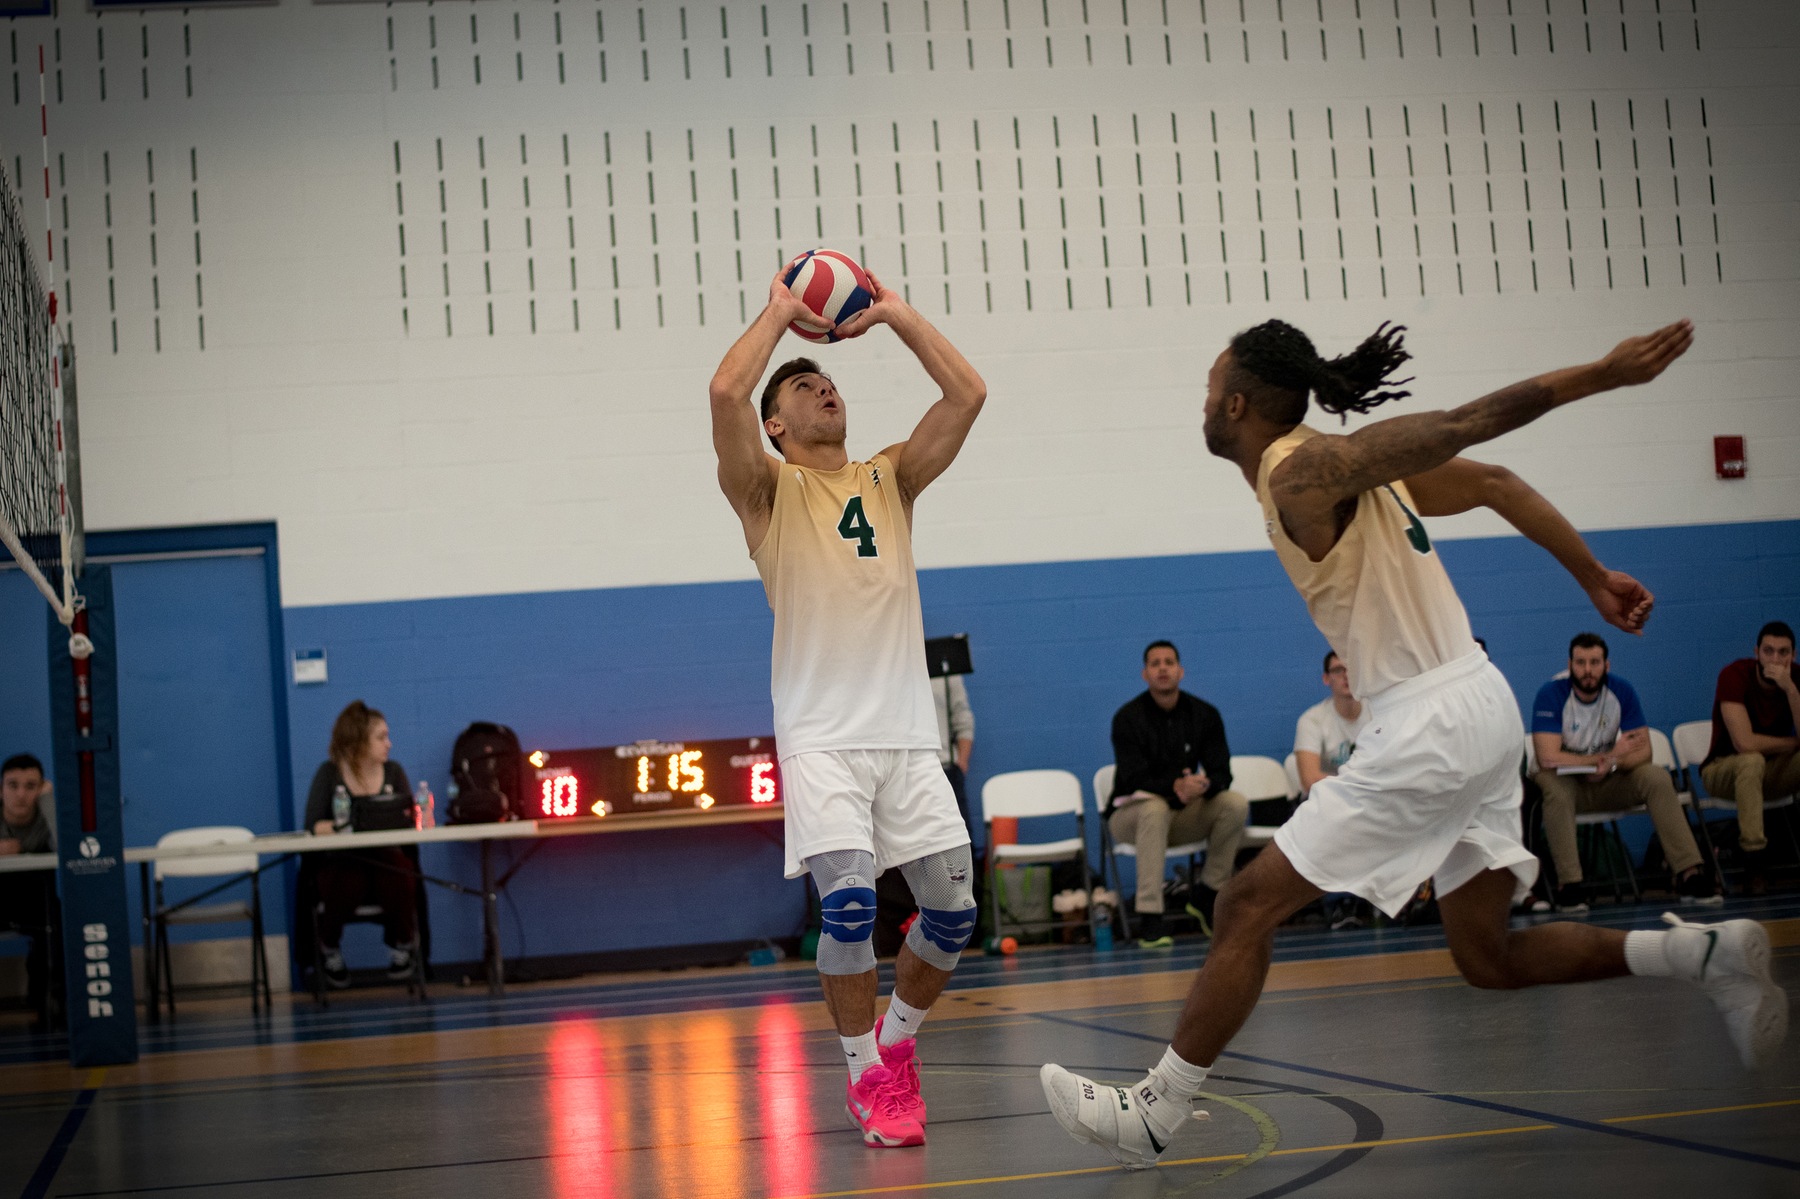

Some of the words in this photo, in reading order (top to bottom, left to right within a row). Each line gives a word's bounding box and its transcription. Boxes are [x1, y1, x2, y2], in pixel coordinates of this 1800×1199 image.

[836, 495, 879, 559] 4
[542, 775, 578, 816] 10
[751, 762, 776, 803] 6
[83, 923, 114, 1018] senoh
[1082, 1082, 1095, 1101] 203
[1140, 1087, 1158, 1106] CKZ
